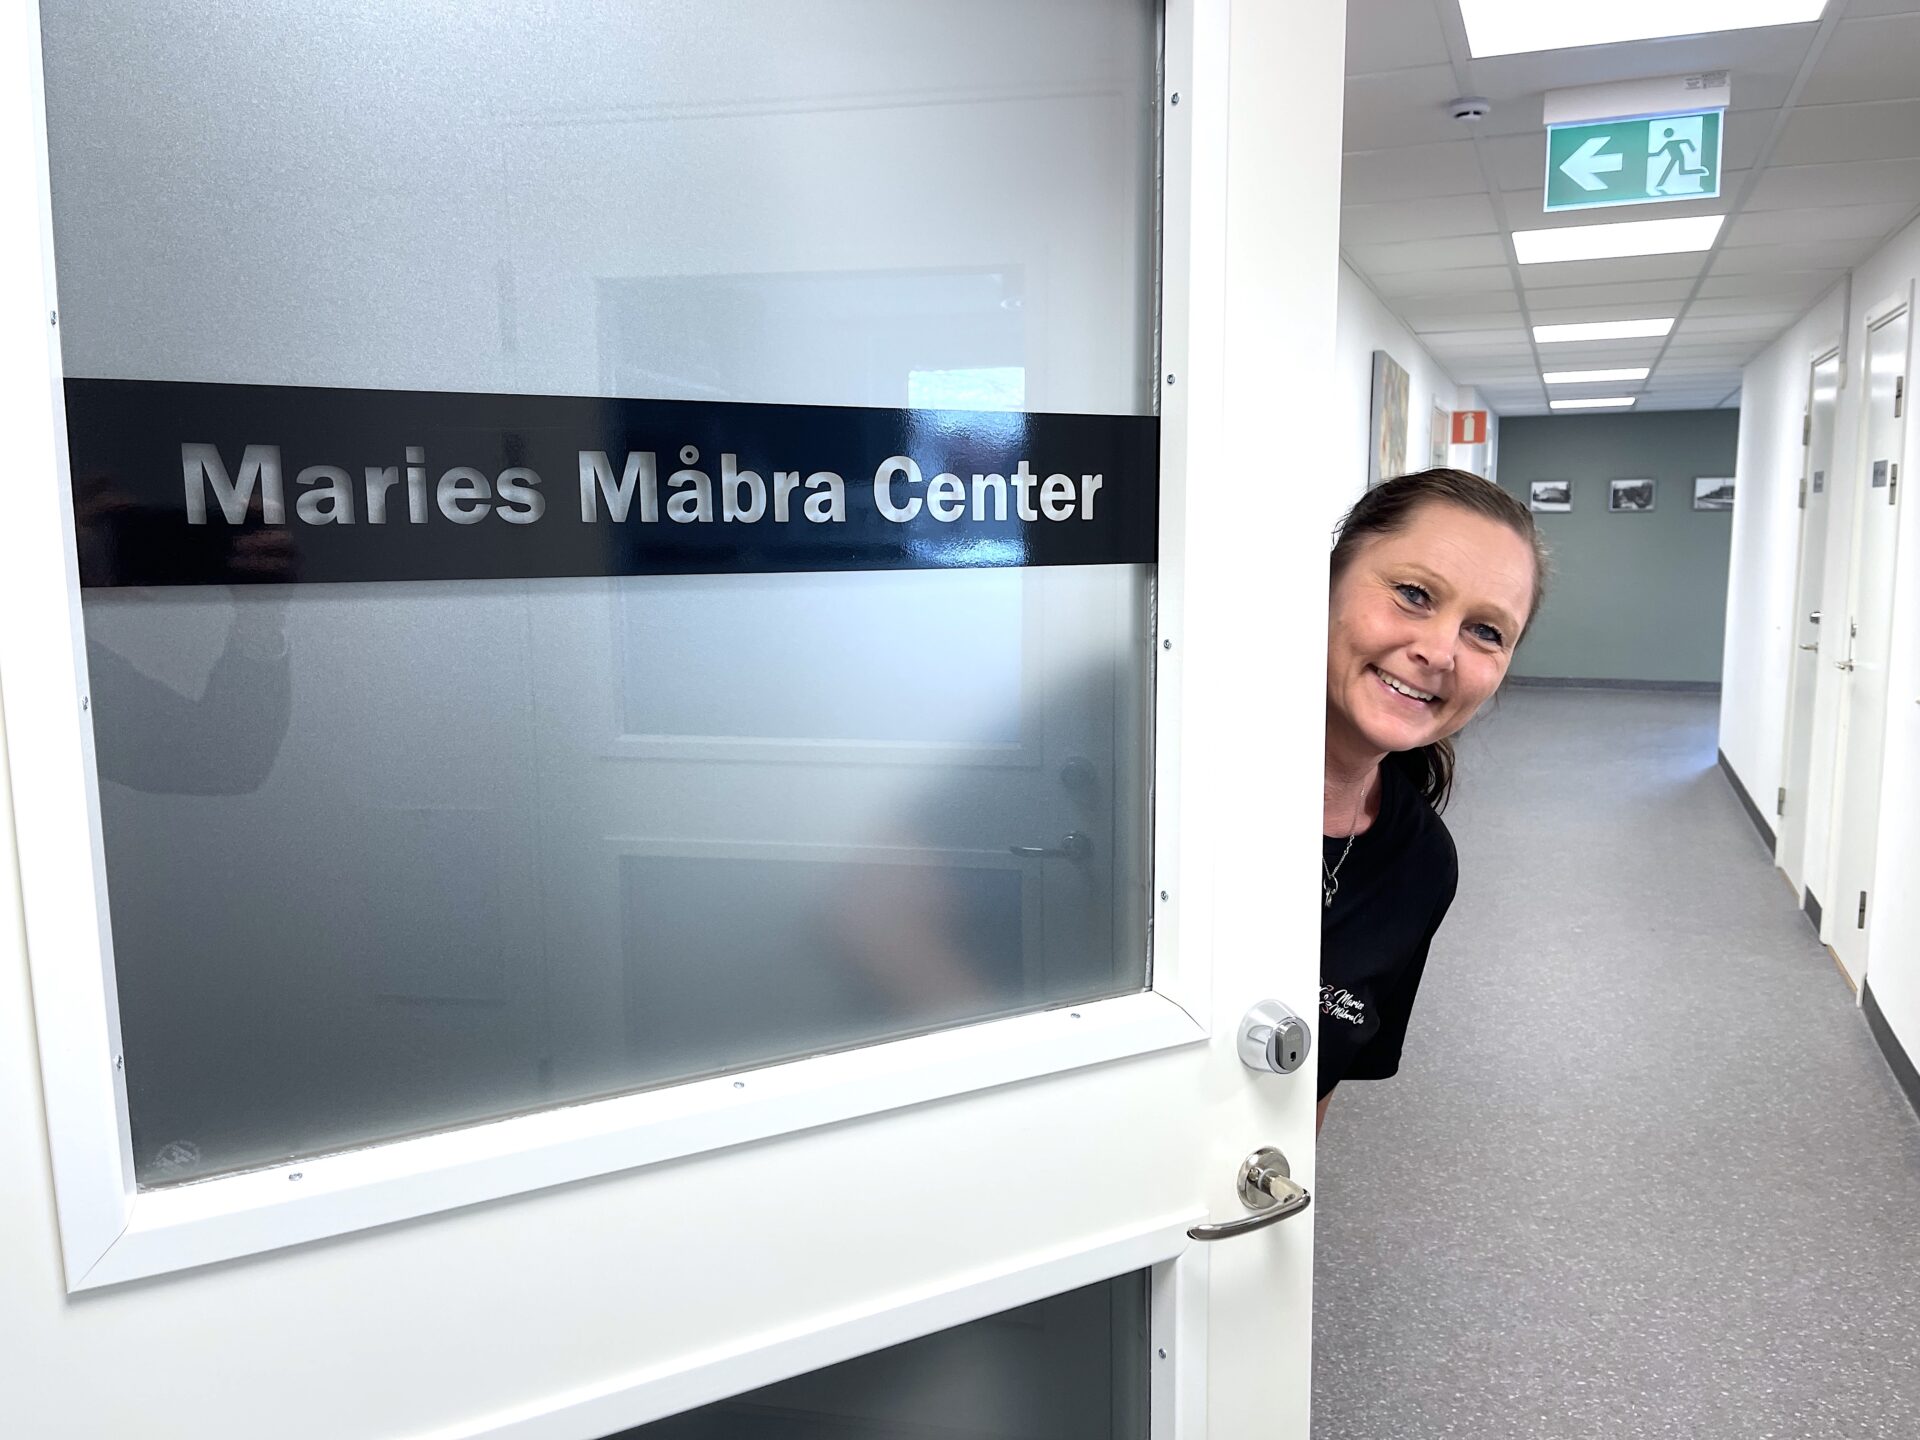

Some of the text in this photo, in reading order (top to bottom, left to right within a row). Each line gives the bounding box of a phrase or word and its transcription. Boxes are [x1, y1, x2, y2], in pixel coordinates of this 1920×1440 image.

[181, 442, 1104, 525] Maries Måbra Center
